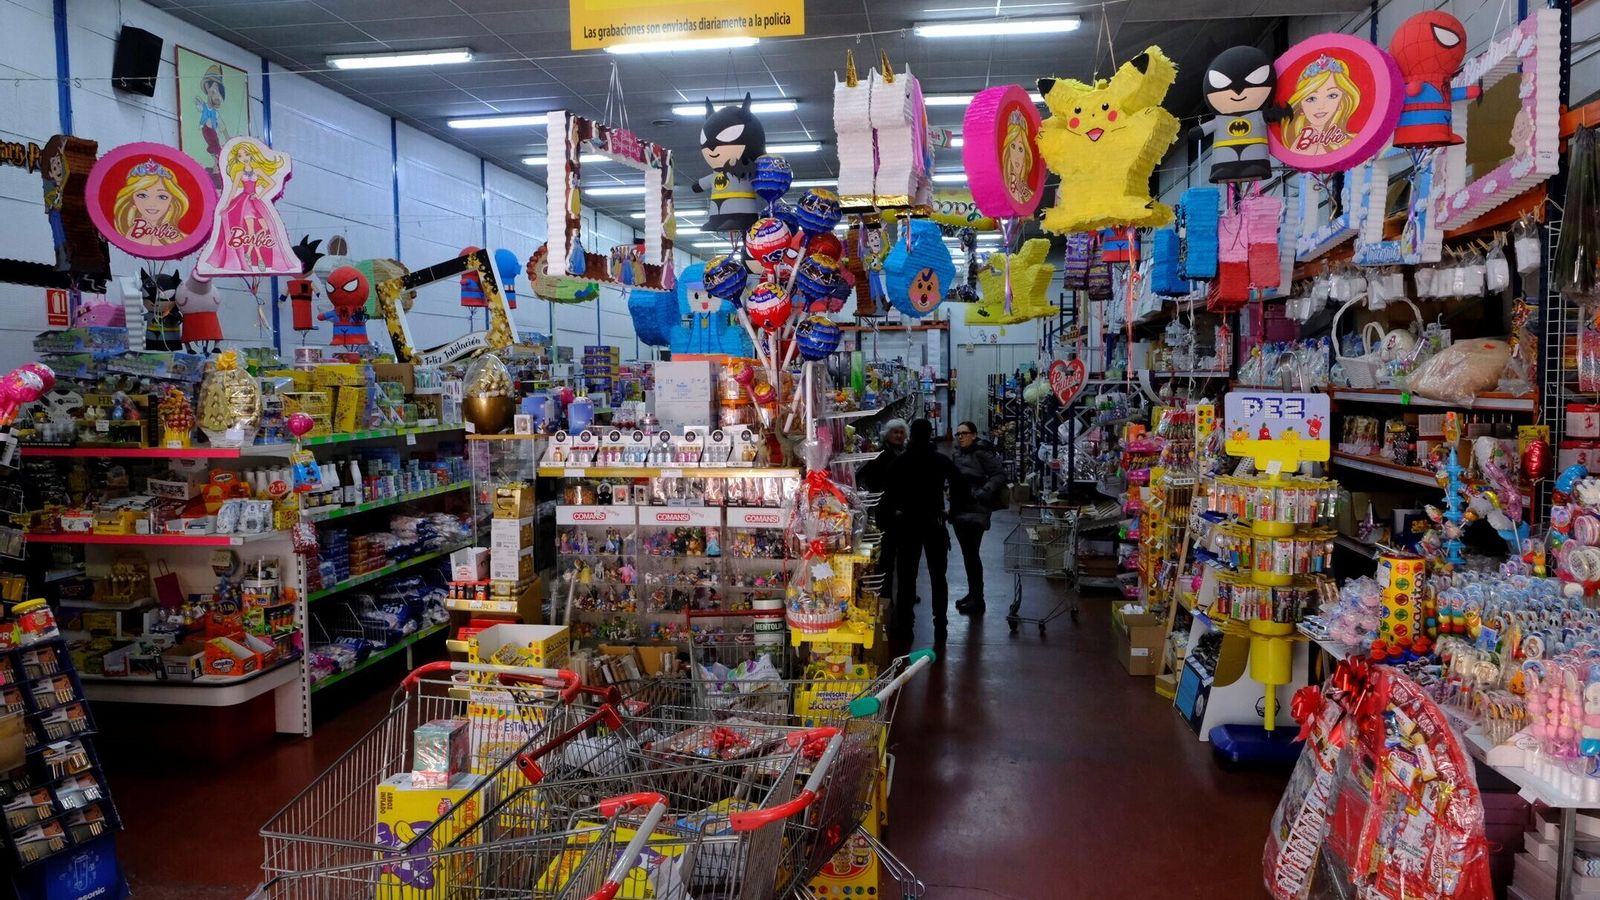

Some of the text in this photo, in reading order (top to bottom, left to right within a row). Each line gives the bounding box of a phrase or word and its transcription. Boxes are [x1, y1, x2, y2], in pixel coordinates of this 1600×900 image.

[583, 12, 791, 41] Las grabaciones son enviadas diariamente a la policia
[1296, 124, 1346, 150] Barbie
[130, 218, 179, 240] Barbie
[228, 227, 275, 248] Barbie
[424, 336, 481, 366] Feliz Jubilación
[1242, 396, 1305, 419] PEZ
[572, 511, 607, 521] COMANSI
[655, 512, 691, 522] COMANSI
[744, 513, 780, 523] COMANSI
[1411, 571, 1424, 643] acasitos
